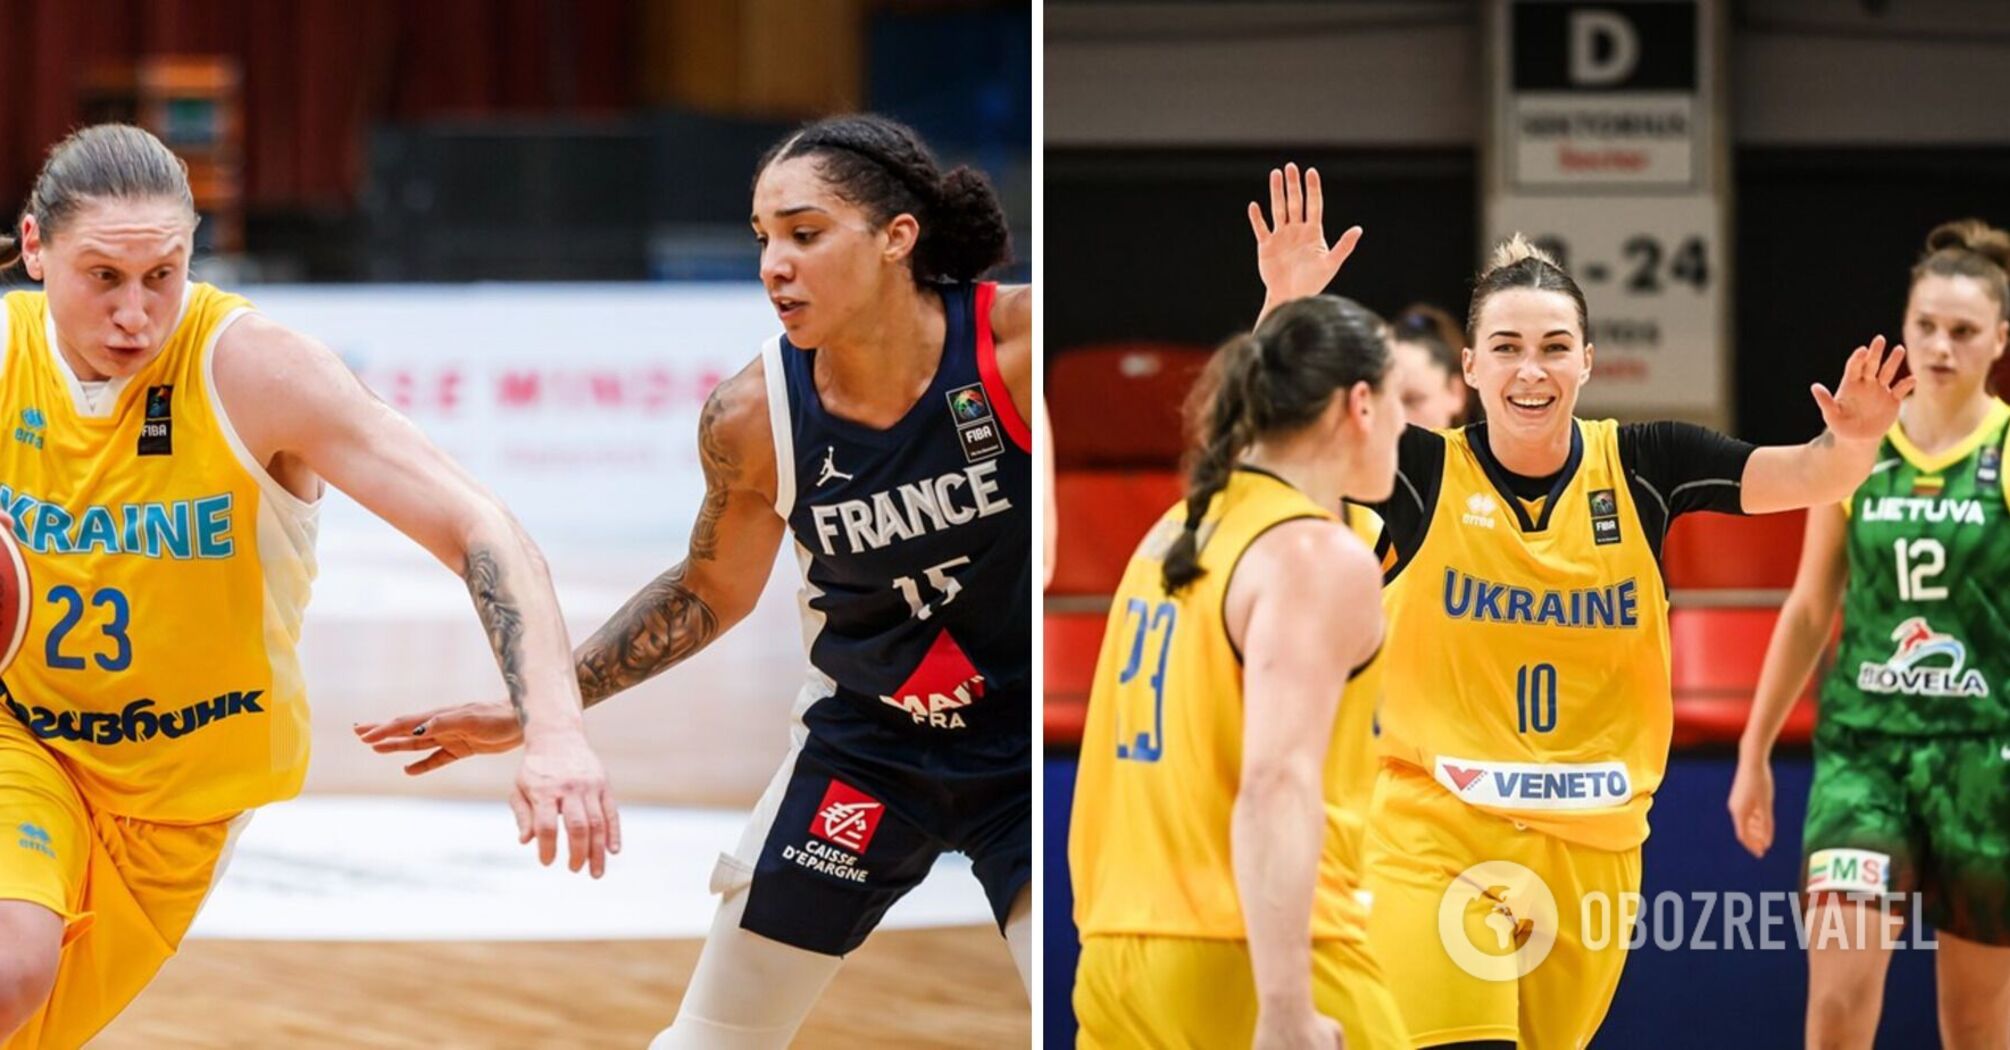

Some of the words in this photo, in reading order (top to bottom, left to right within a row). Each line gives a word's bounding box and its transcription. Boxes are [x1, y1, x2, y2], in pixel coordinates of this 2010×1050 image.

[1570, 11, 1640, 83] D
[142, 423, 167, 437] FIBA
[966, 425, 993, 444] FIBA
[811, 459, 1013, 555] FRANCE
[1862, 497, 1985, 525] LIETUVA
[892, 555, 971, 620] 15
[1443, 565, 1638, 629] UKRAINE
[1893, 537, 1949, 601] 12
[45, 585, 132, 672] 23
[1517, 663, 1557, 734] 10
[1493, 770, 1628, 800] VENETO
[782, 845, 869, 883] D'EPARGNE
[805, 840, 858, 866] CAISSE
